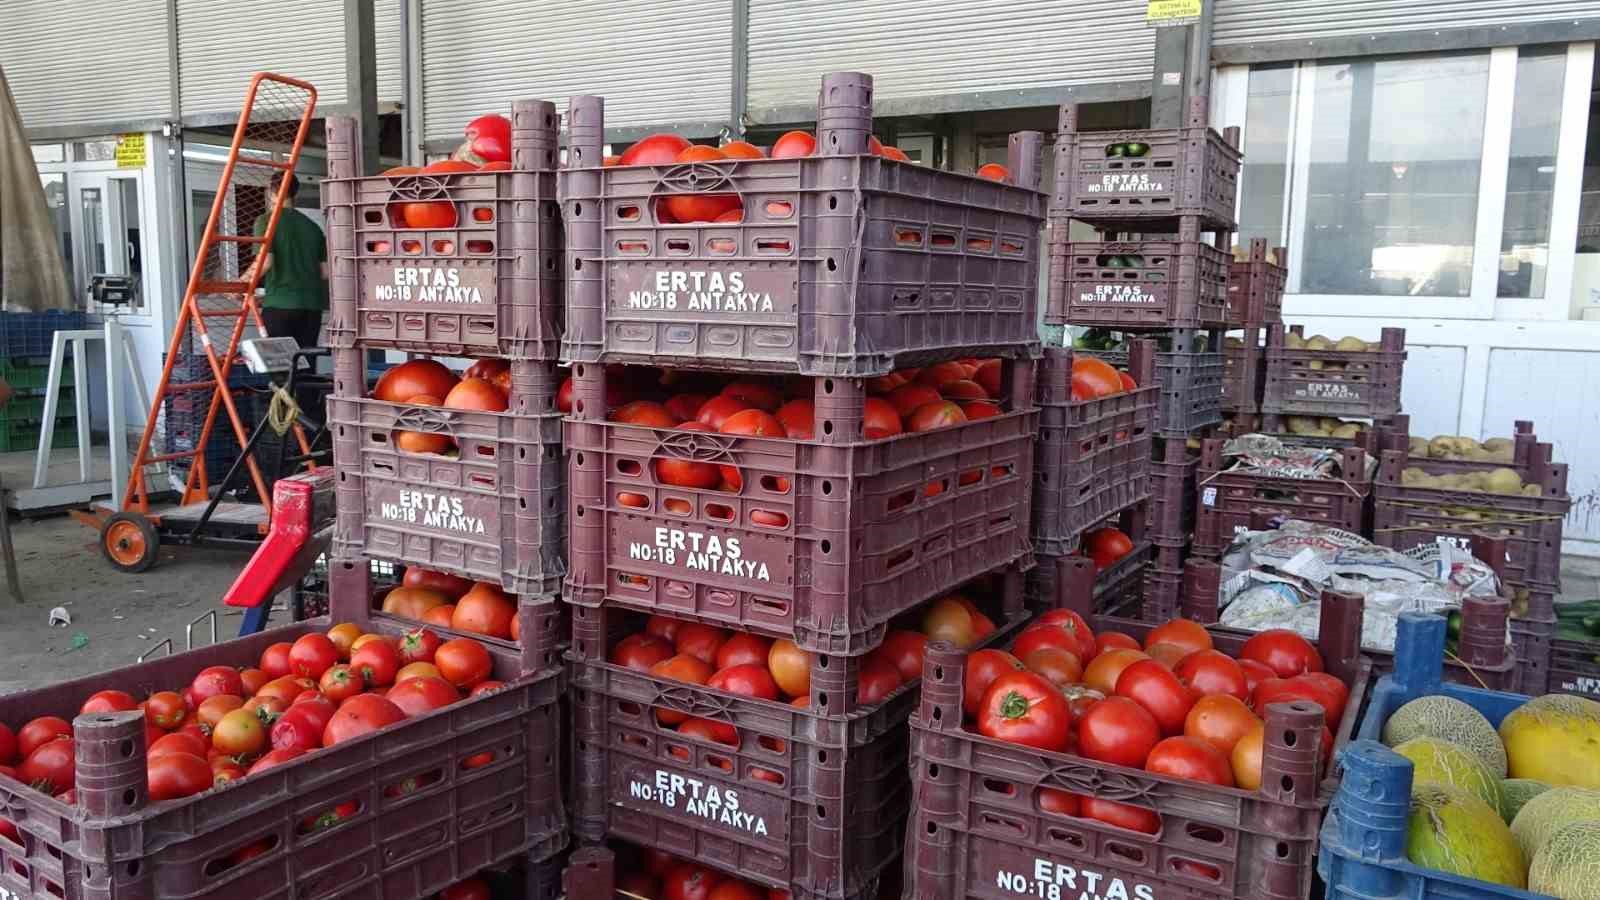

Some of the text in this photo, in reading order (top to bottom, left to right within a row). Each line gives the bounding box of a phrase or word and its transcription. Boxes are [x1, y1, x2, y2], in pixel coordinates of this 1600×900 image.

[1102, 174, 1149, 184] ERTAS
[1119, 183, 1163, 192] ANTAKYA
[394, 268, 460, 287] ERTAS
[655, 271, 745, 294] ERTAS
[375, 285, 482, 303] NO:18 ANTAKYA
[1095, 285, 1141, 295] ERTAS
[1111, 294, 1156, 303] ANTAKYA
[629, 291, 774, 312] NO:18 ANTAKYA
[1307, 383, 1348, 393] ERTAS
[400, 490, 464, 516] ERTAS
[381, 502, 485, 534] NO:18 ANTAKYA
[655, 527, 742, 559] ERTAS
[1436, 536, 1470, 550] ERT
[630, 543, 770, 582] NO:18 ANTAKYA
[655, 770, 740, 811] ERTAS
[630, 780, 768, 835] NO:18 ANTAKYA
[997, 870, 1061, 900] NO:18
[1034, 859, 1153, 900] ERTAS
